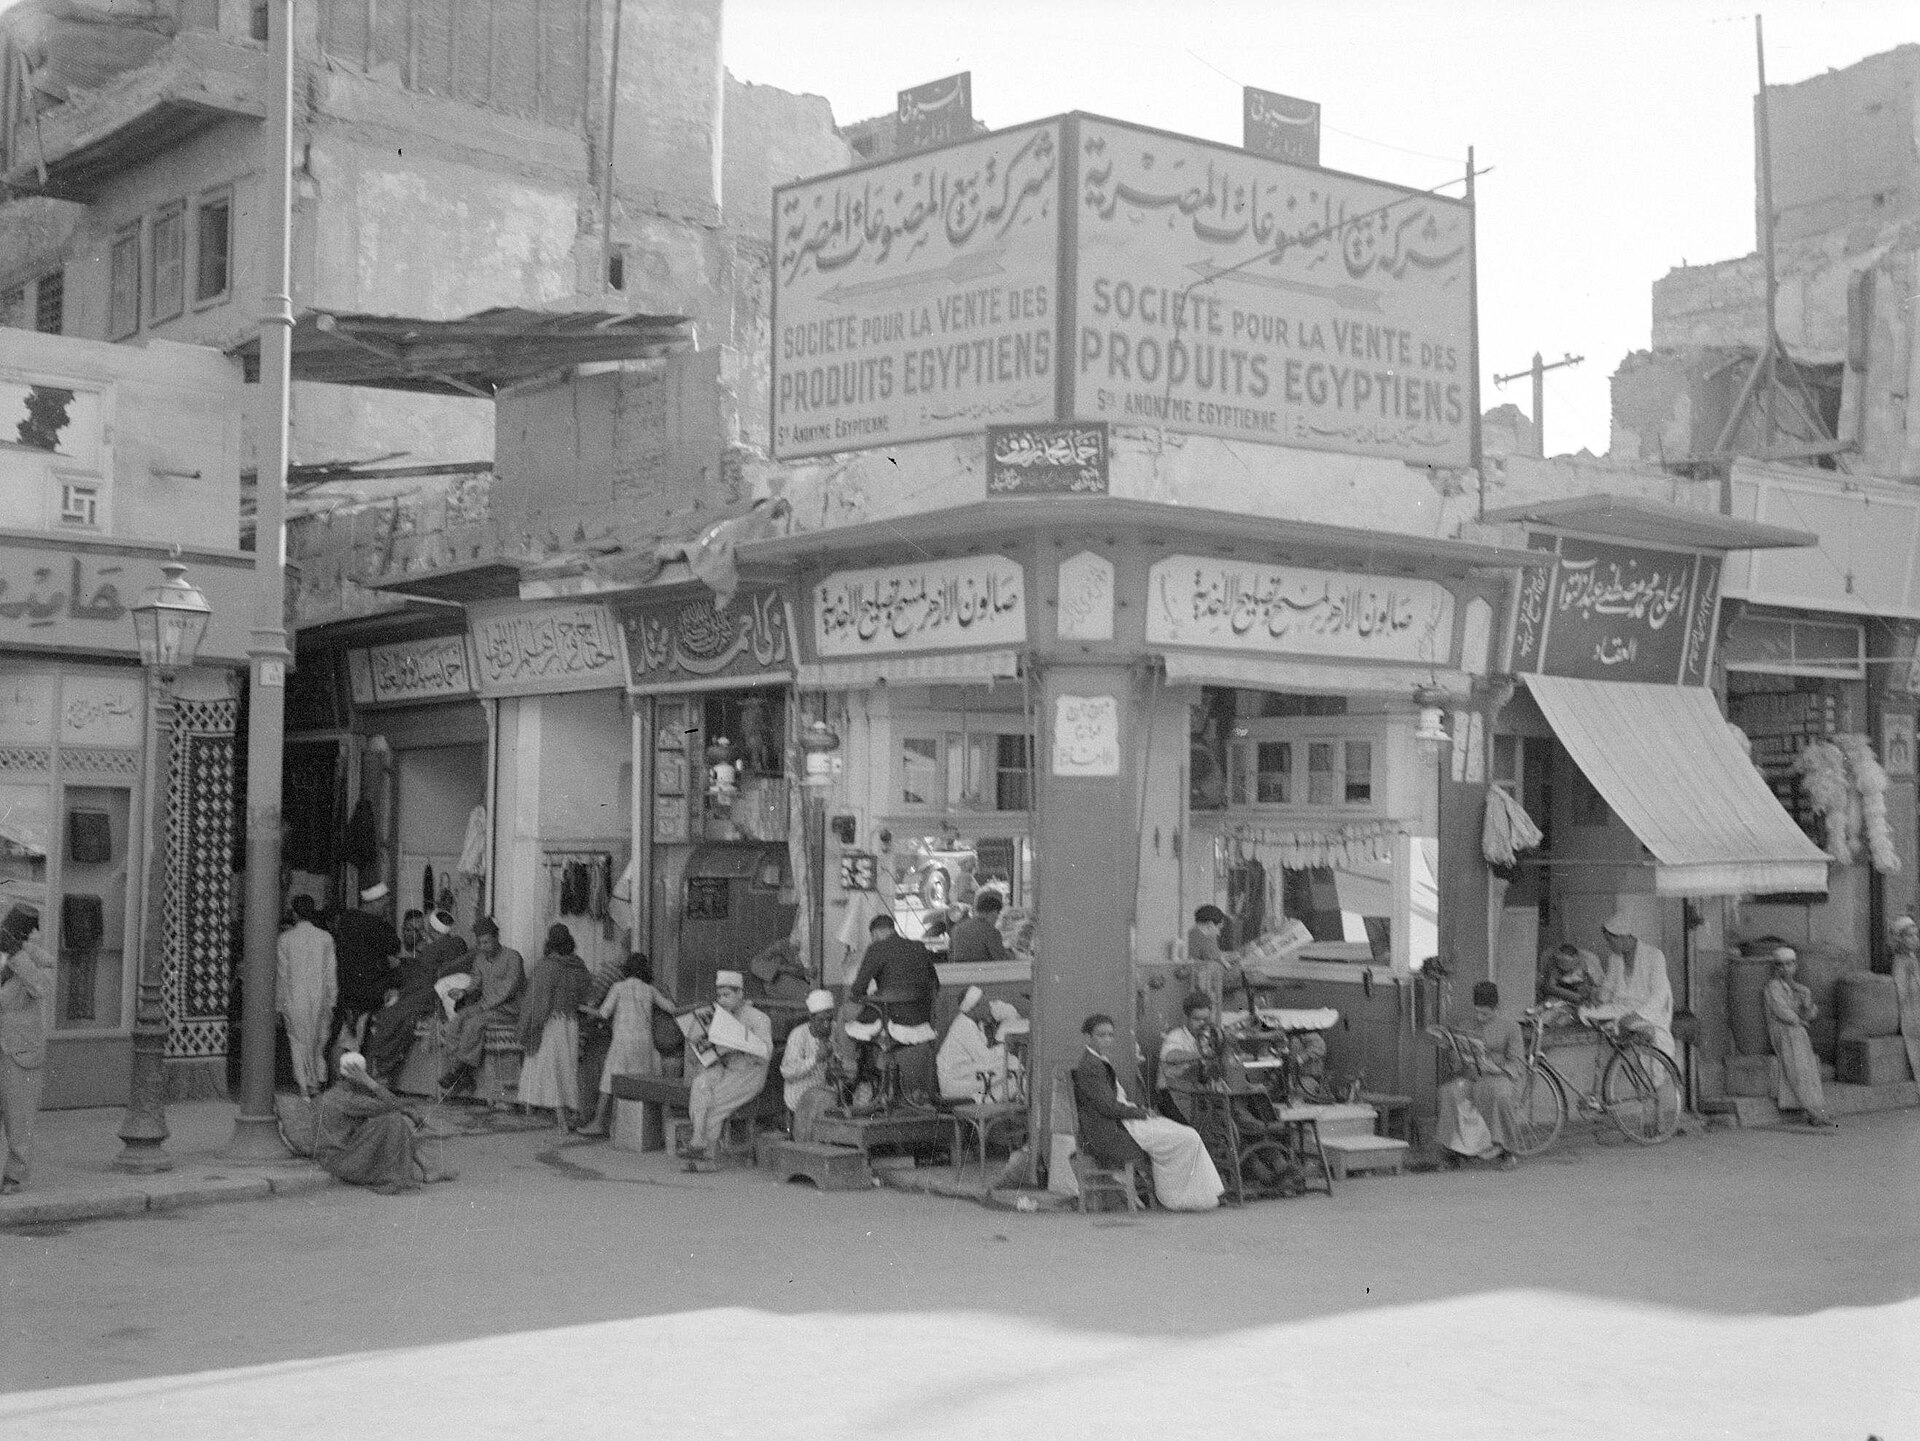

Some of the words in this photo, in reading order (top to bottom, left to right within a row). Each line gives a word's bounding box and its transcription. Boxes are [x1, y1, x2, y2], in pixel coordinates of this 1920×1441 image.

[861, 311, 905, 347] POUR
[910, 307, 932, 339] LA
[937, 285, 1001, 335] VENTE
[1009, 285, 1048, 321] DES
[1232, 310, 1289, 349] POUR
[1299, 321, 1326, 353] LA
[1331, 319, 1413, 368] VENTE
[1420, 342, 1458, 374] DES
[779, 355, 894, 415] PRODUITS
[903, 328, 1051, 397] EGYPTIENS
[1080, 327, 1270, 399] PRODUITS
[1284, 357, 1463, 425] EGYPTIENS
